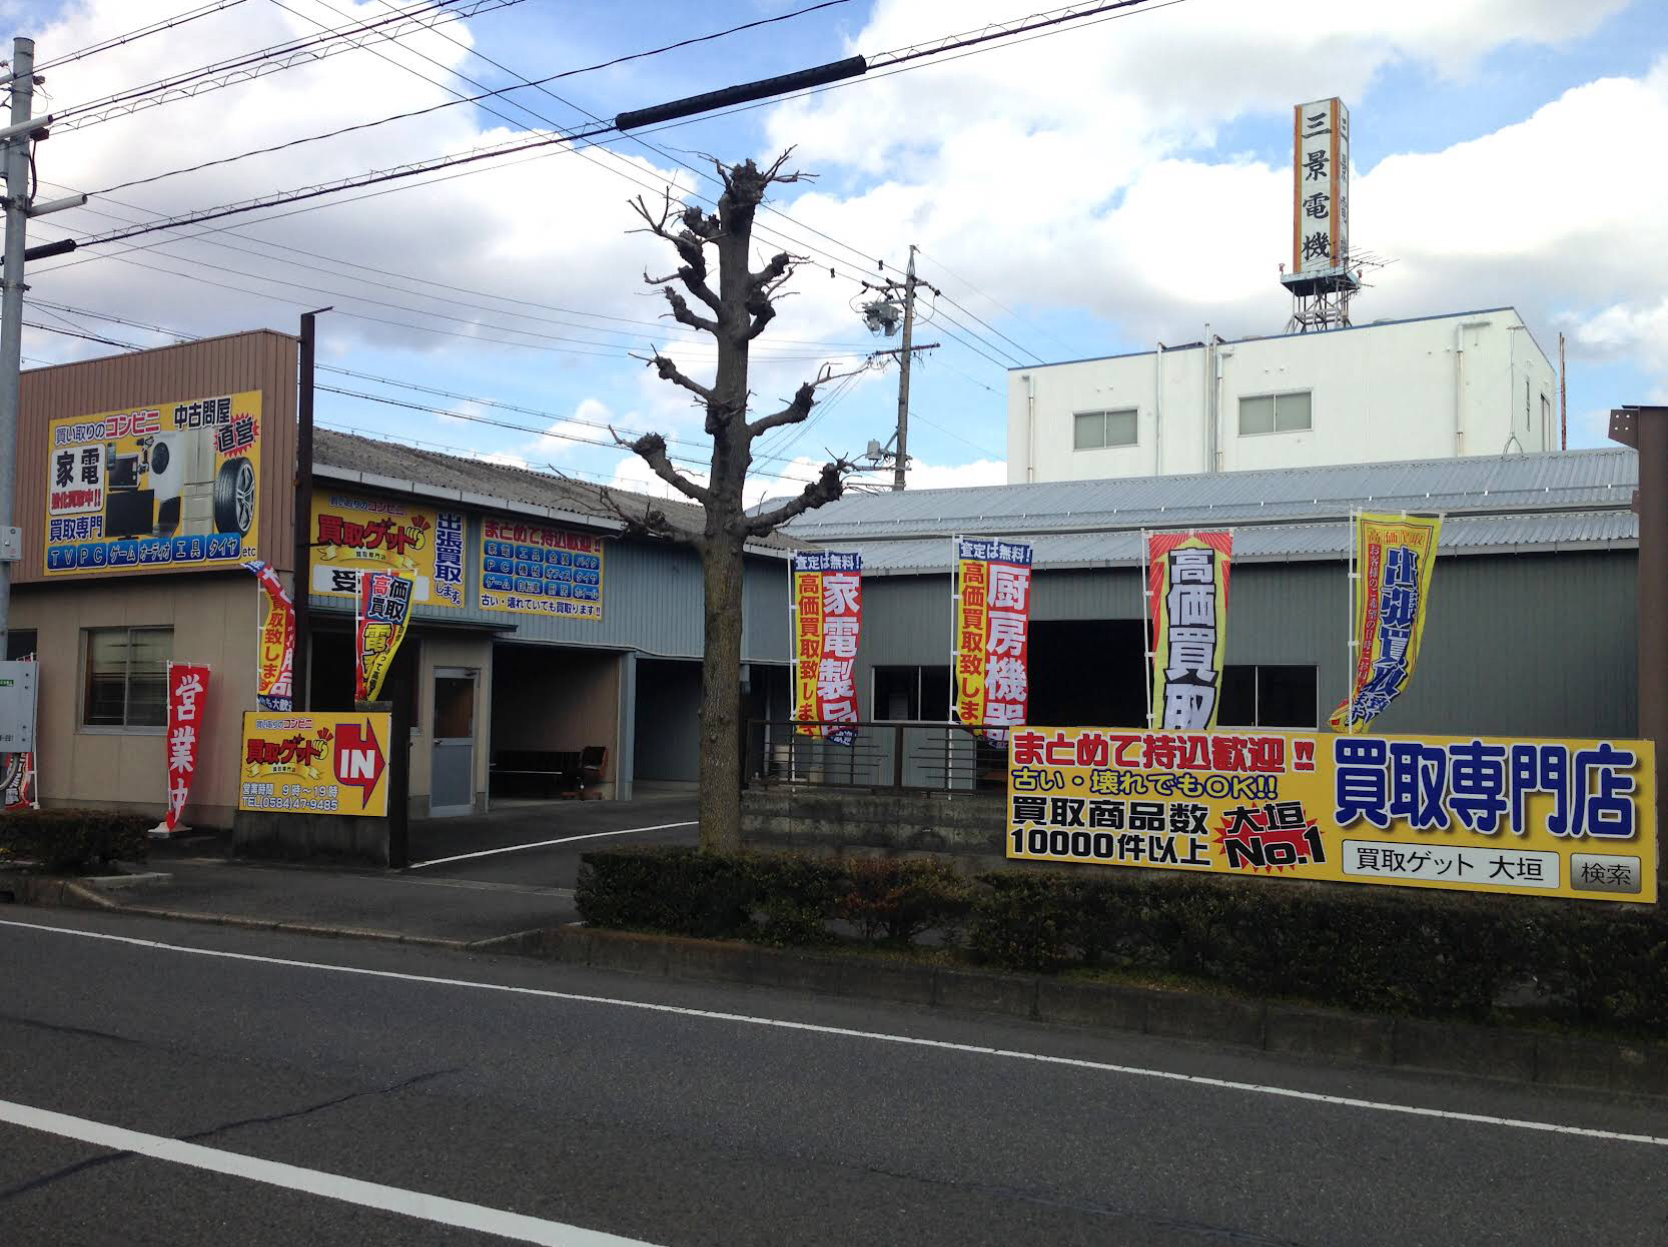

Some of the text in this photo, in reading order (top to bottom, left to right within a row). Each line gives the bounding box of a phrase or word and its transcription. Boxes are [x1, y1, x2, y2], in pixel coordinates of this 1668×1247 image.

[1301, 112, 1332, 261] 三景電機
[56, 410, 161, 445] 買い取りのコンビニ
[174, 398, 231, 429] 中古問屋
[217, 417, 255, 452] 直営
[56, 448, 99, 487] 家電
[49, 515, 103, 541] 買取専門
[318, 514, 421, 555] 買取ゲット
[209, 537, 237, 555] タイヤ
[242, 547, 256, 557] etc
[435, 511, 463, 583] 出張買取
[795, 554, 862, 571] 査定は無料!
[960, 542, 1032, 563] 査定は無料!
[817, 573, 861, 735] 家電製品
[960, 562, 985, 728] 高価買取致しま
[1163, 548, 1219, 729] 高価買取
[170, 674, 203, 823] 営業中
[246, 734, 321, 766] 買取ゲット
[340, 749, 375, 779] IN
[1334, 738, 1637, 839] 買取専門店
[1011, 795, 1210, 836] 買取商品数
[1223, 800, 1307, 833] 大垣
[1010, 828, 1212, 867] 10000件以上
[1224, 824, 1327, 869] No.1
[1356, 847, 1545, 882] 買取ゲット 大垣
[1581, 861, 1632, 887] 検索
